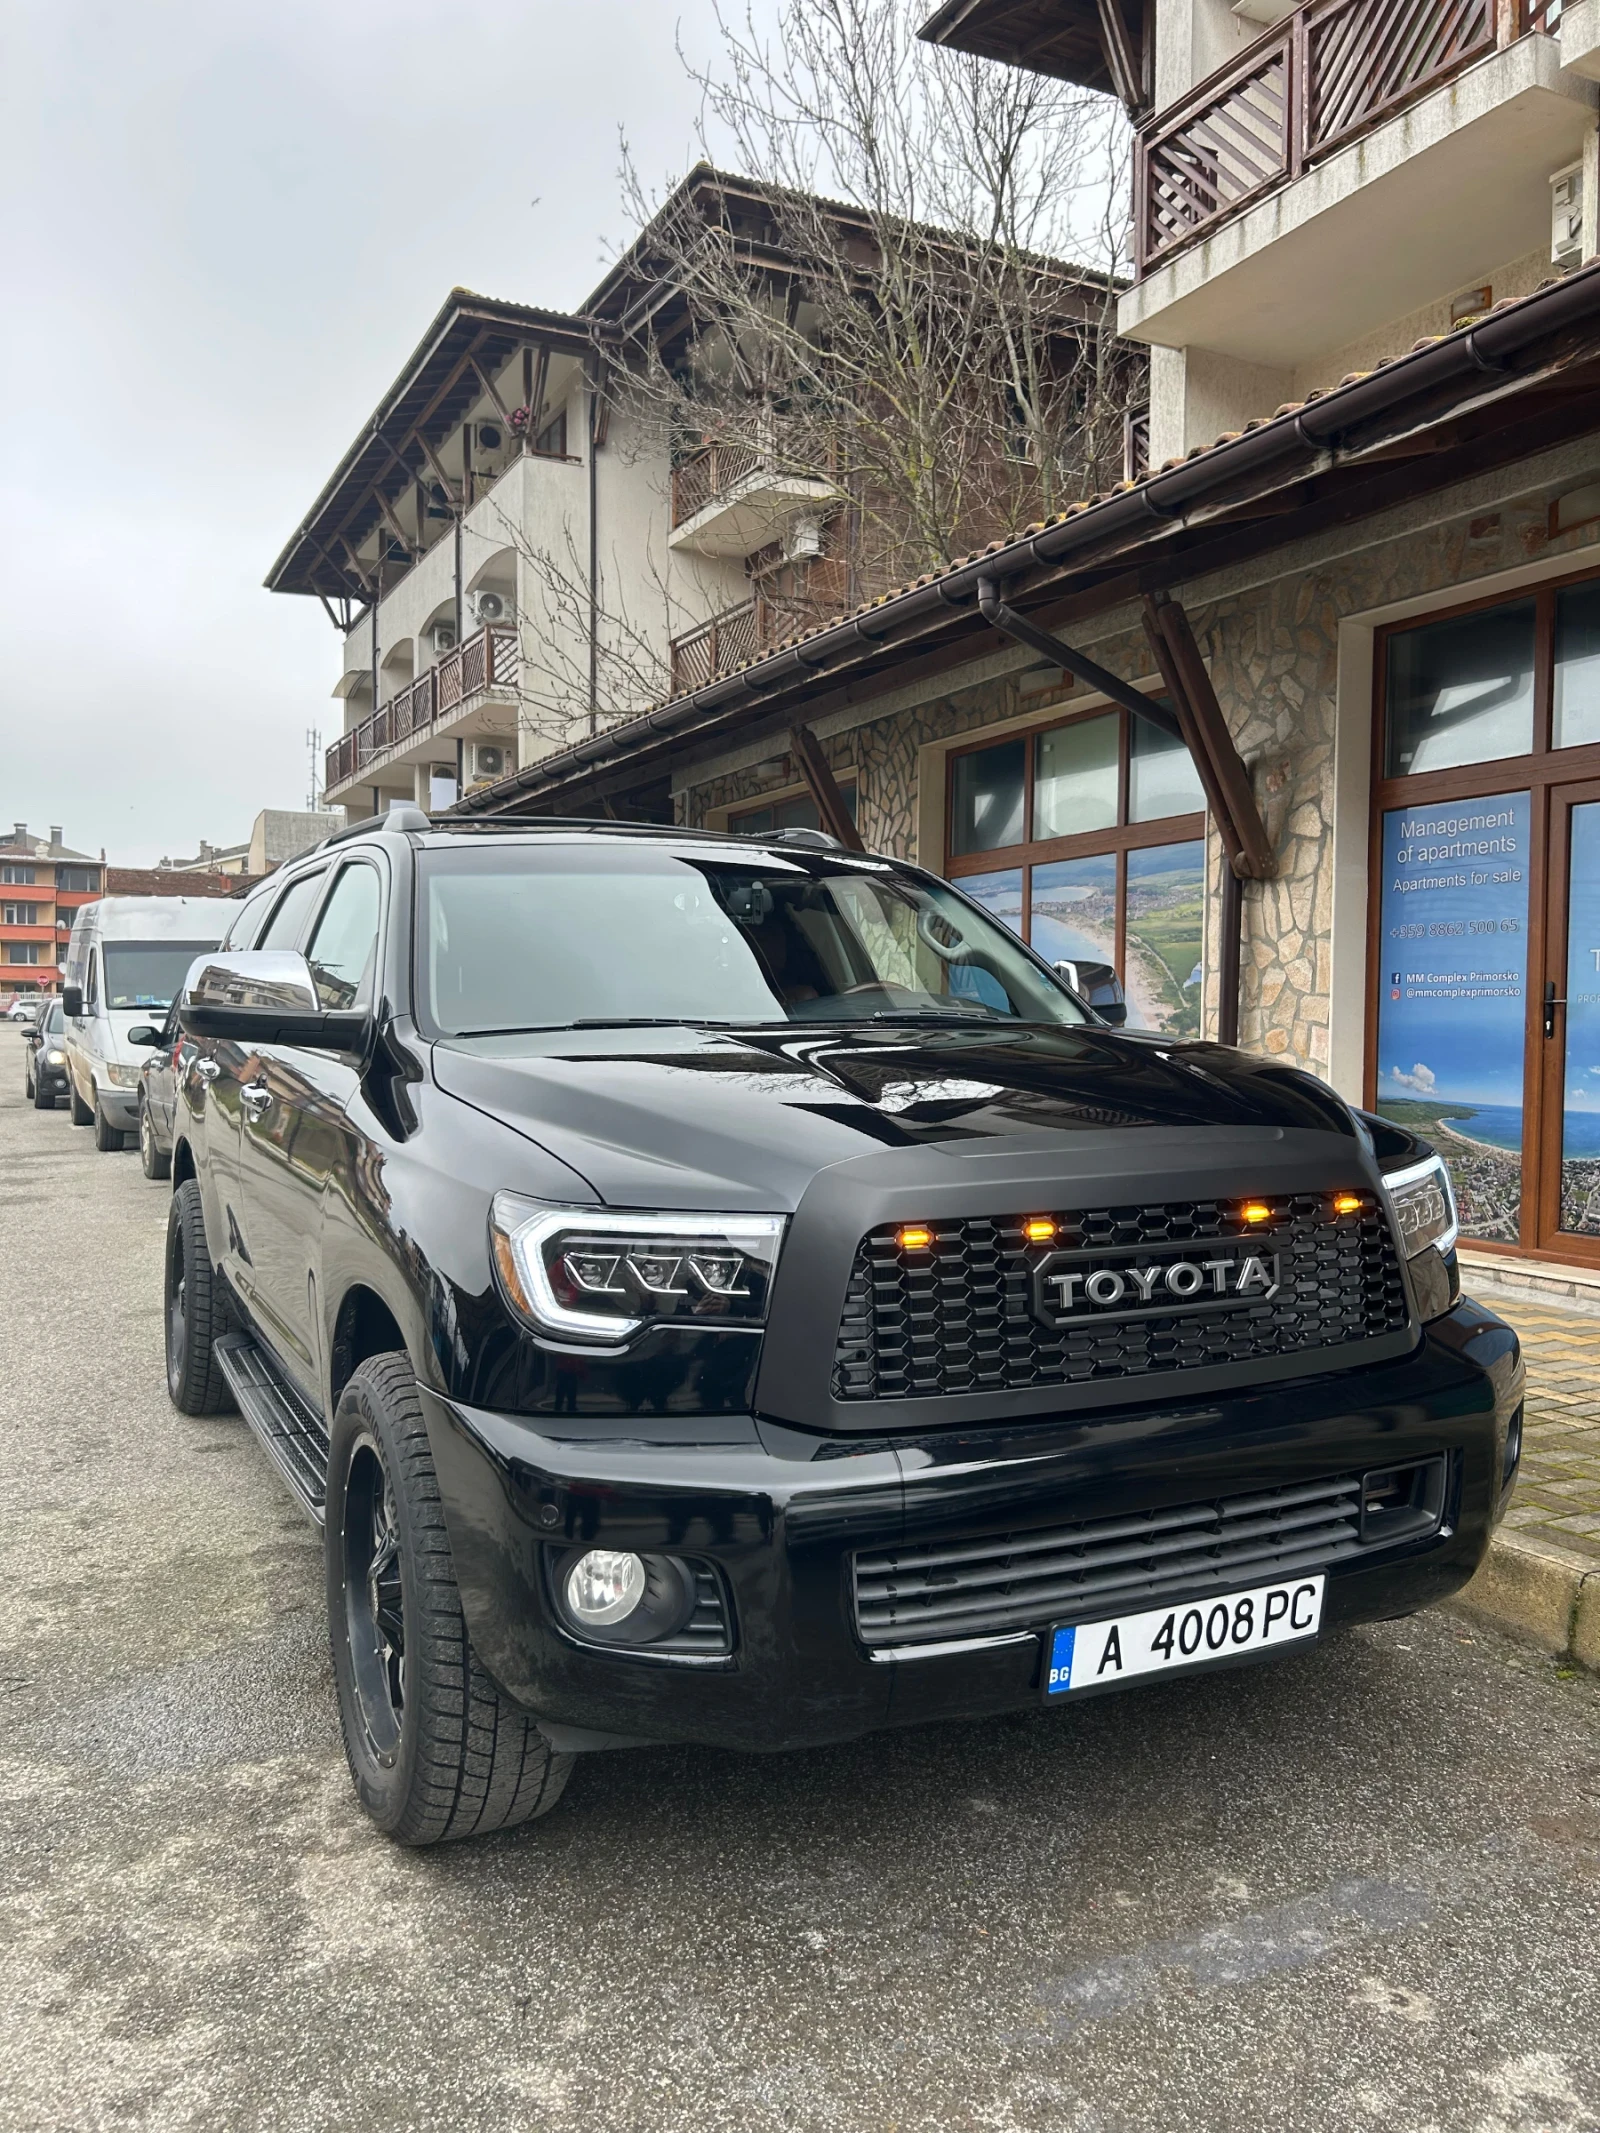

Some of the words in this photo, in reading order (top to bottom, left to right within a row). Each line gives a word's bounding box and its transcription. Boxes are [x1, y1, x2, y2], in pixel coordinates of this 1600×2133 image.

[1401, 808, 1515, 839] Management
[1397, 845, 1414, 864] of
[1417, 836, 1516, 864] apartments
[1393, 873, 1466, 894] Apartments
[1470, 871, 1488, 885] for
[1492, 868, 1521, 884] sale
[1390, 924, 1425, 939] +359
[1469, 920, 1495, 934] 500
[1500, 918, 1519, 933] 65
[1406, 973, 1424, 984] MM
[1427, 972, 1467, 985] Complex
[1470, 971, 1519, 982] Primorsko
[1406, 986, 1521, 999] @mmcomplexprimorsko
[1047, 1256, 1272, 1309] TOYOTA
[1096, 1624, 1123, 1675] A
[1049, 1666, 1070, 1684] BG
